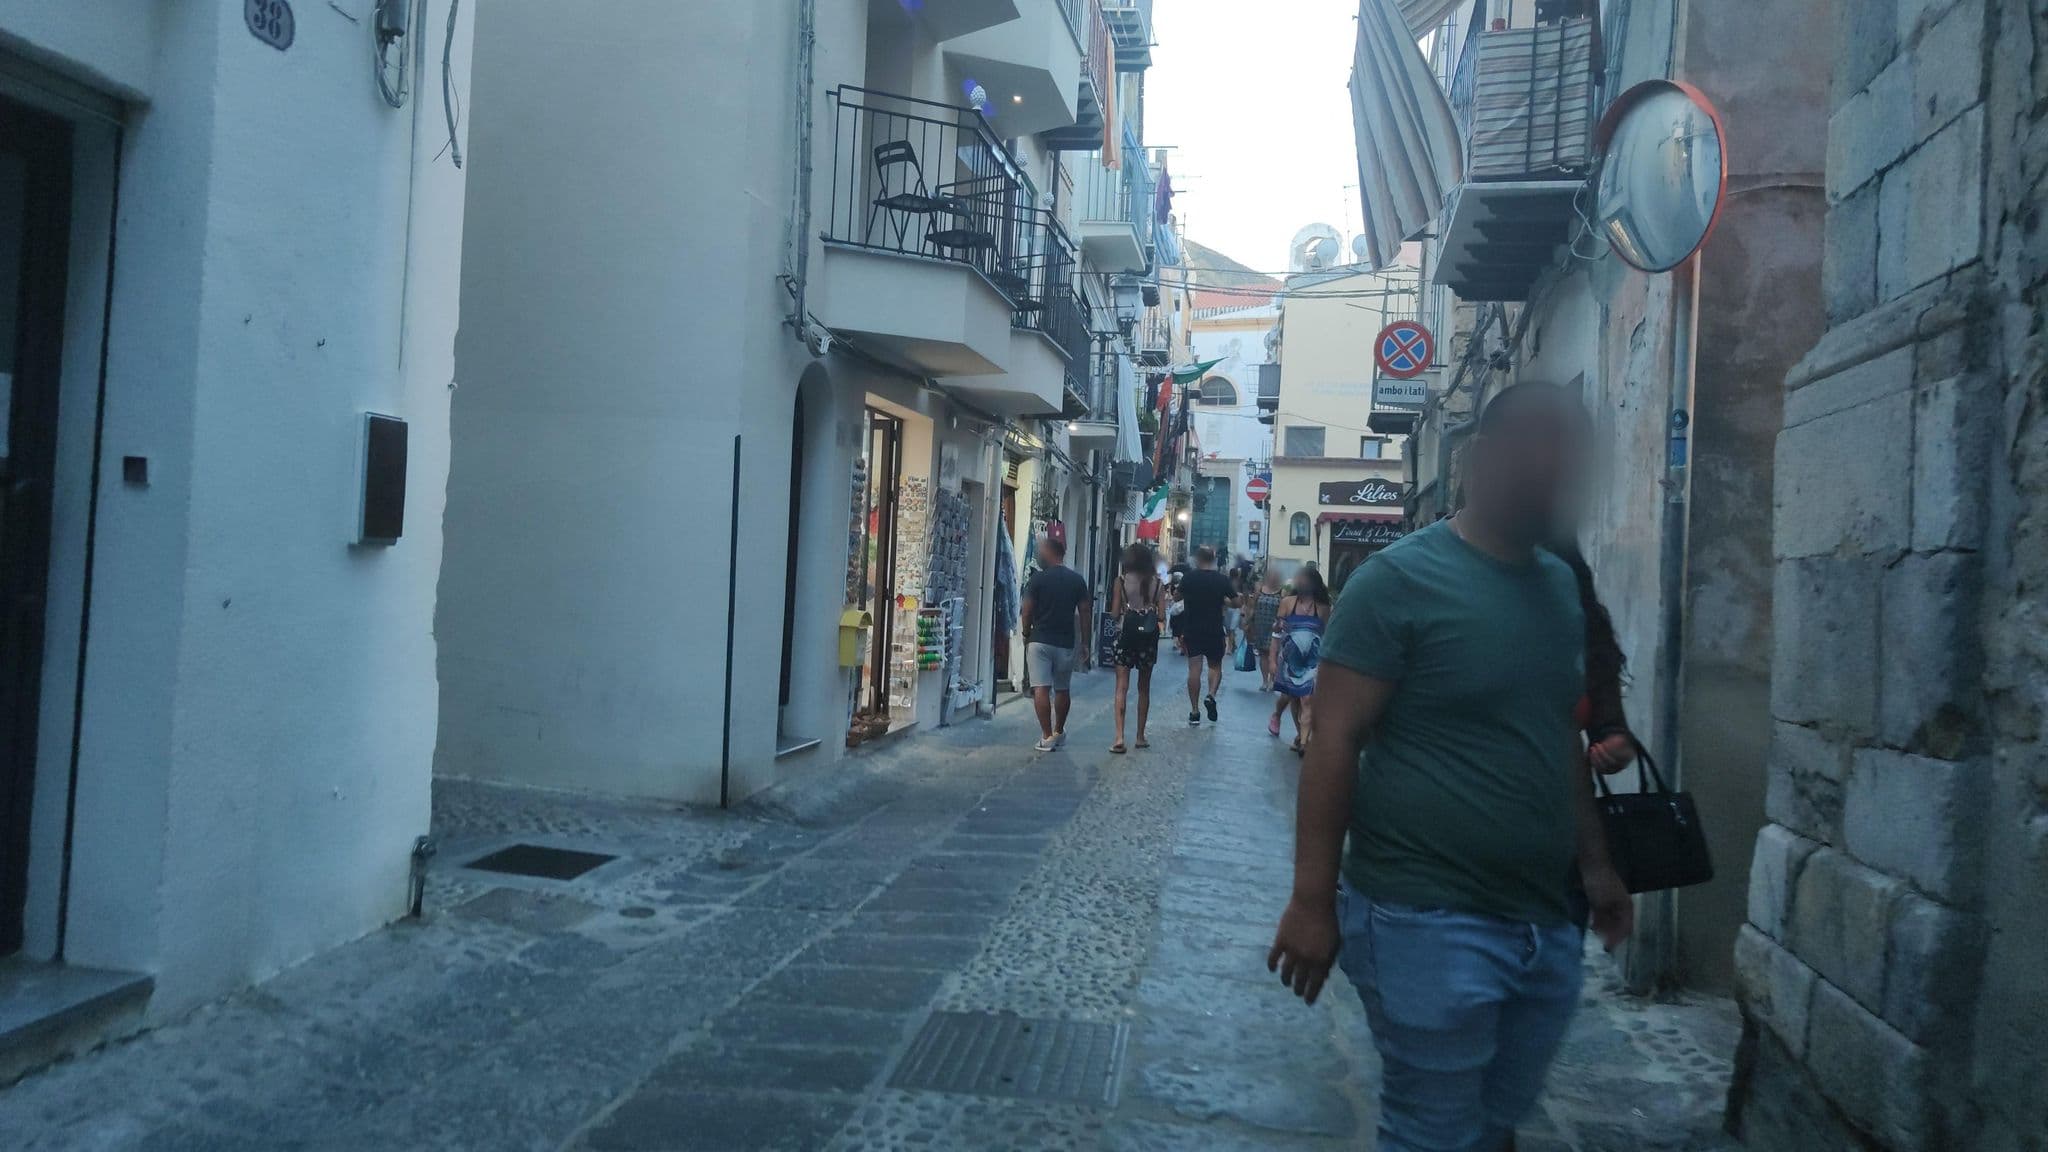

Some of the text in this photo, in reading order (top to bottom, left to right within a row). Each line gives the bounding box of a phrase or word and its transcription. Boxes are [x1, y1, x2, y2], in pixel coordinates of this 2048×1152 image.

[254, 0, 282, 39] 38
[1379, 385, 1403, 395] ambo
[1410, 386, 1425, 396] lati
[1350, 482, 1398, 503] Lilies
[1375, 526, 1403, 538] Drin
